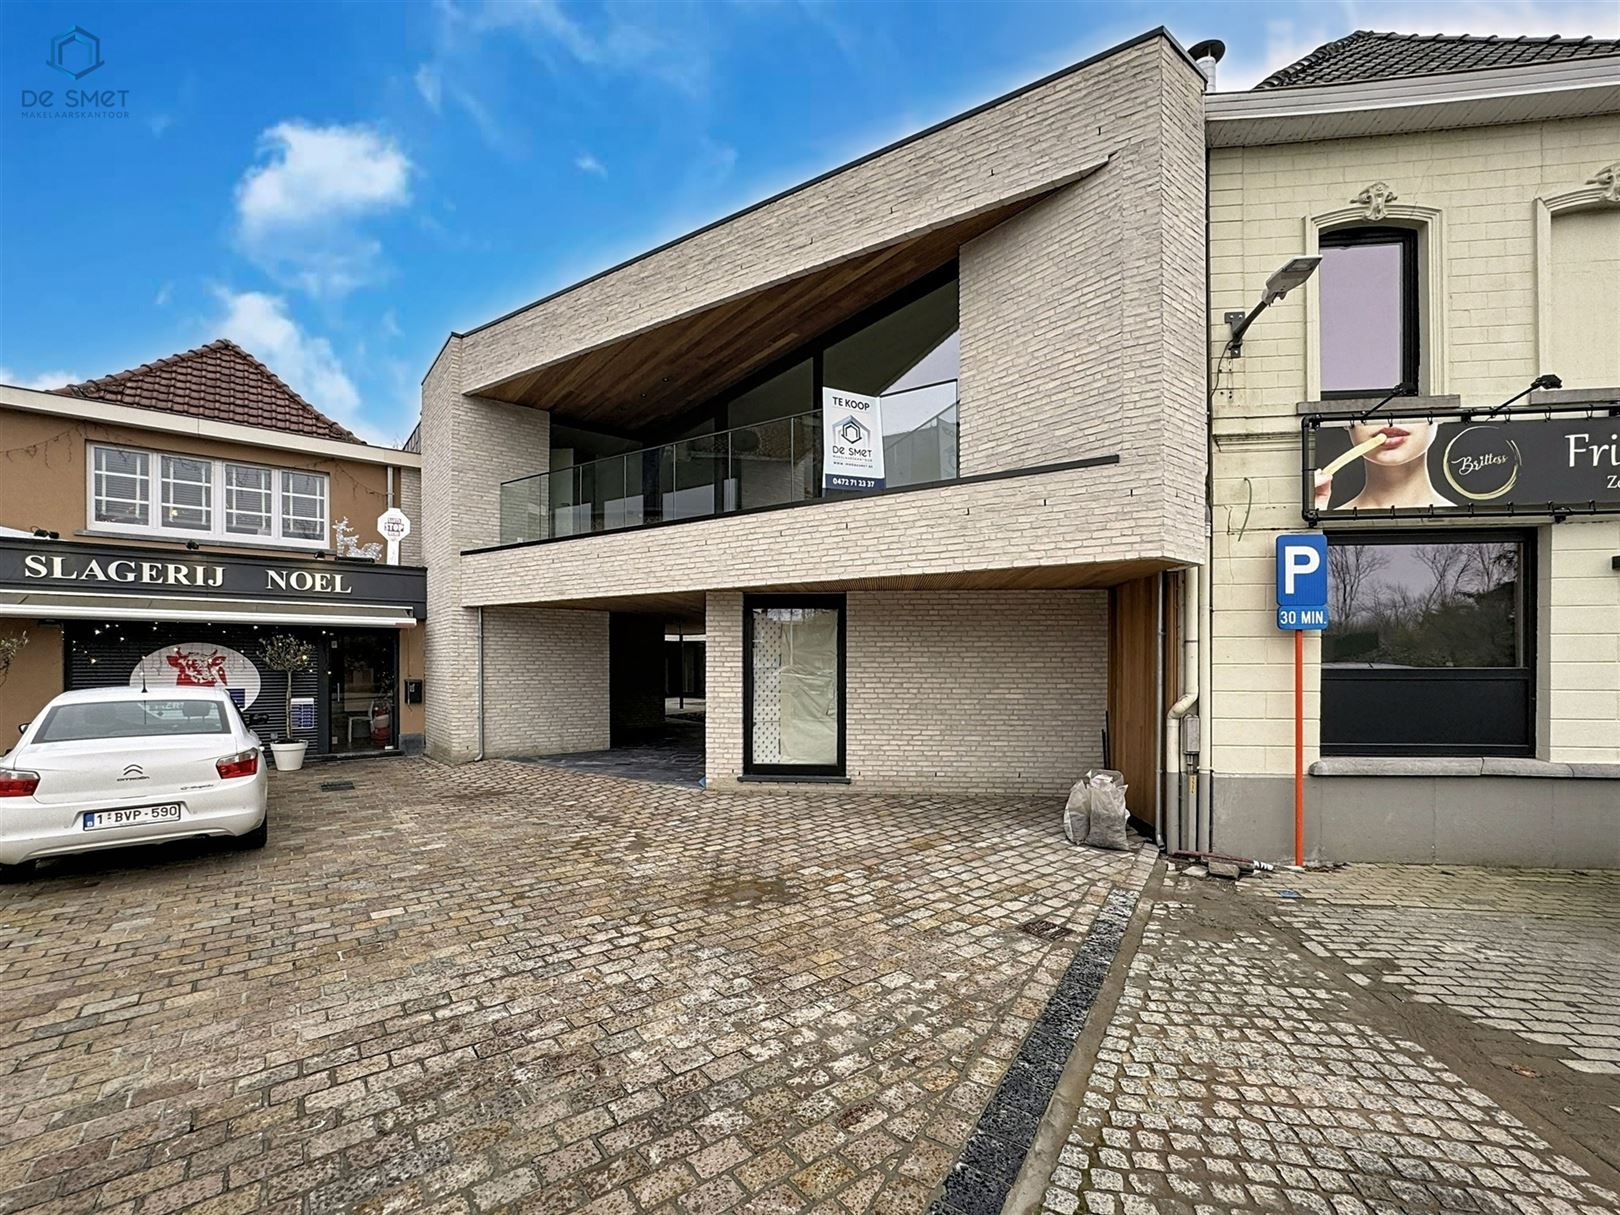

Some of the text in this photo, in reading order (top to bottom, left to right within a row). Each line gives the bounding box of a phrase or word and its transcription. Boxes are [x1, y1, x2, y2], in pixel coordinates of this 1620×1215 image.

[832, 396, 870, 411] TE KOOP
[24, 555, 352, 594] SLAGERIJ NOEL
[1284, 545, 1320, 594] P
[1280, 611, 1327, 624] 30 MIN.
